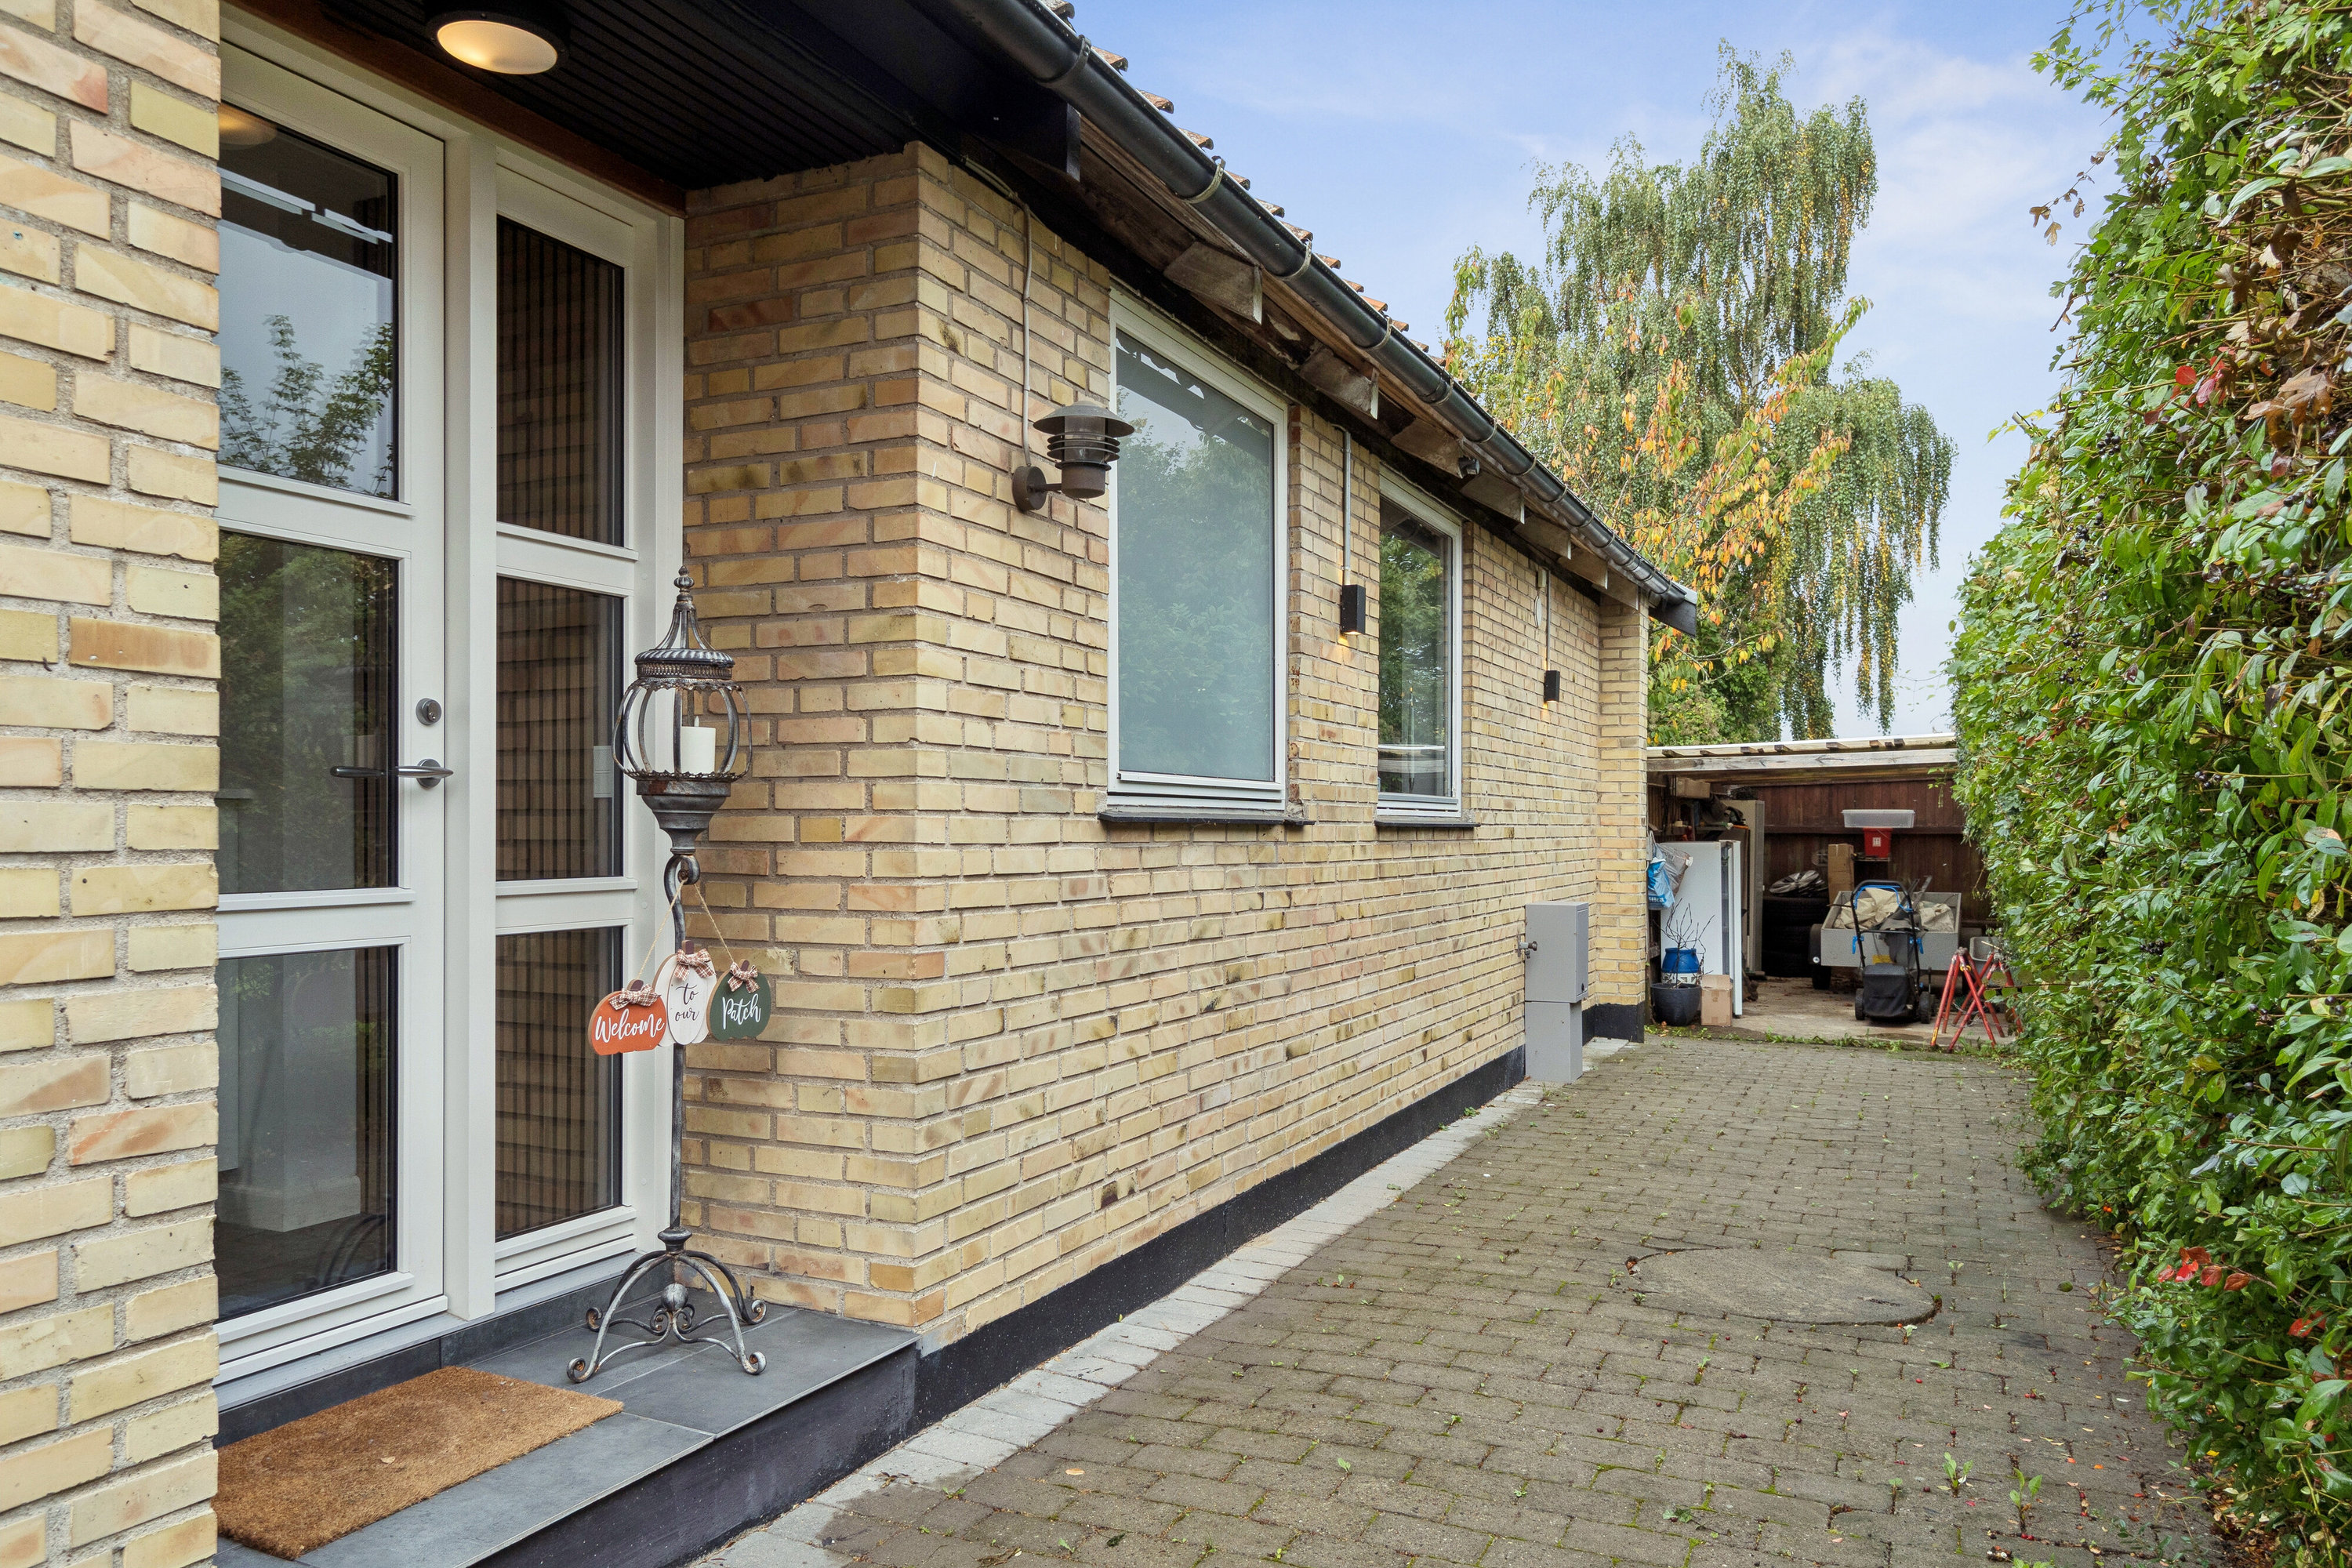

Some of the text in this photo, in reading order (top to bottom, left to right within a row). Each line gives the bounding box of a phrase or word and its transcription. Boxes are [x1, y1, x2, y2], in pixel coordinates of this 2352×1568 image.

[676, 983, 699, 1005] to
[595, 1008, 665, 1043] Welcome
[675, 1007, 699, 1022] our
[722, 993, 761, 1030] Patch
